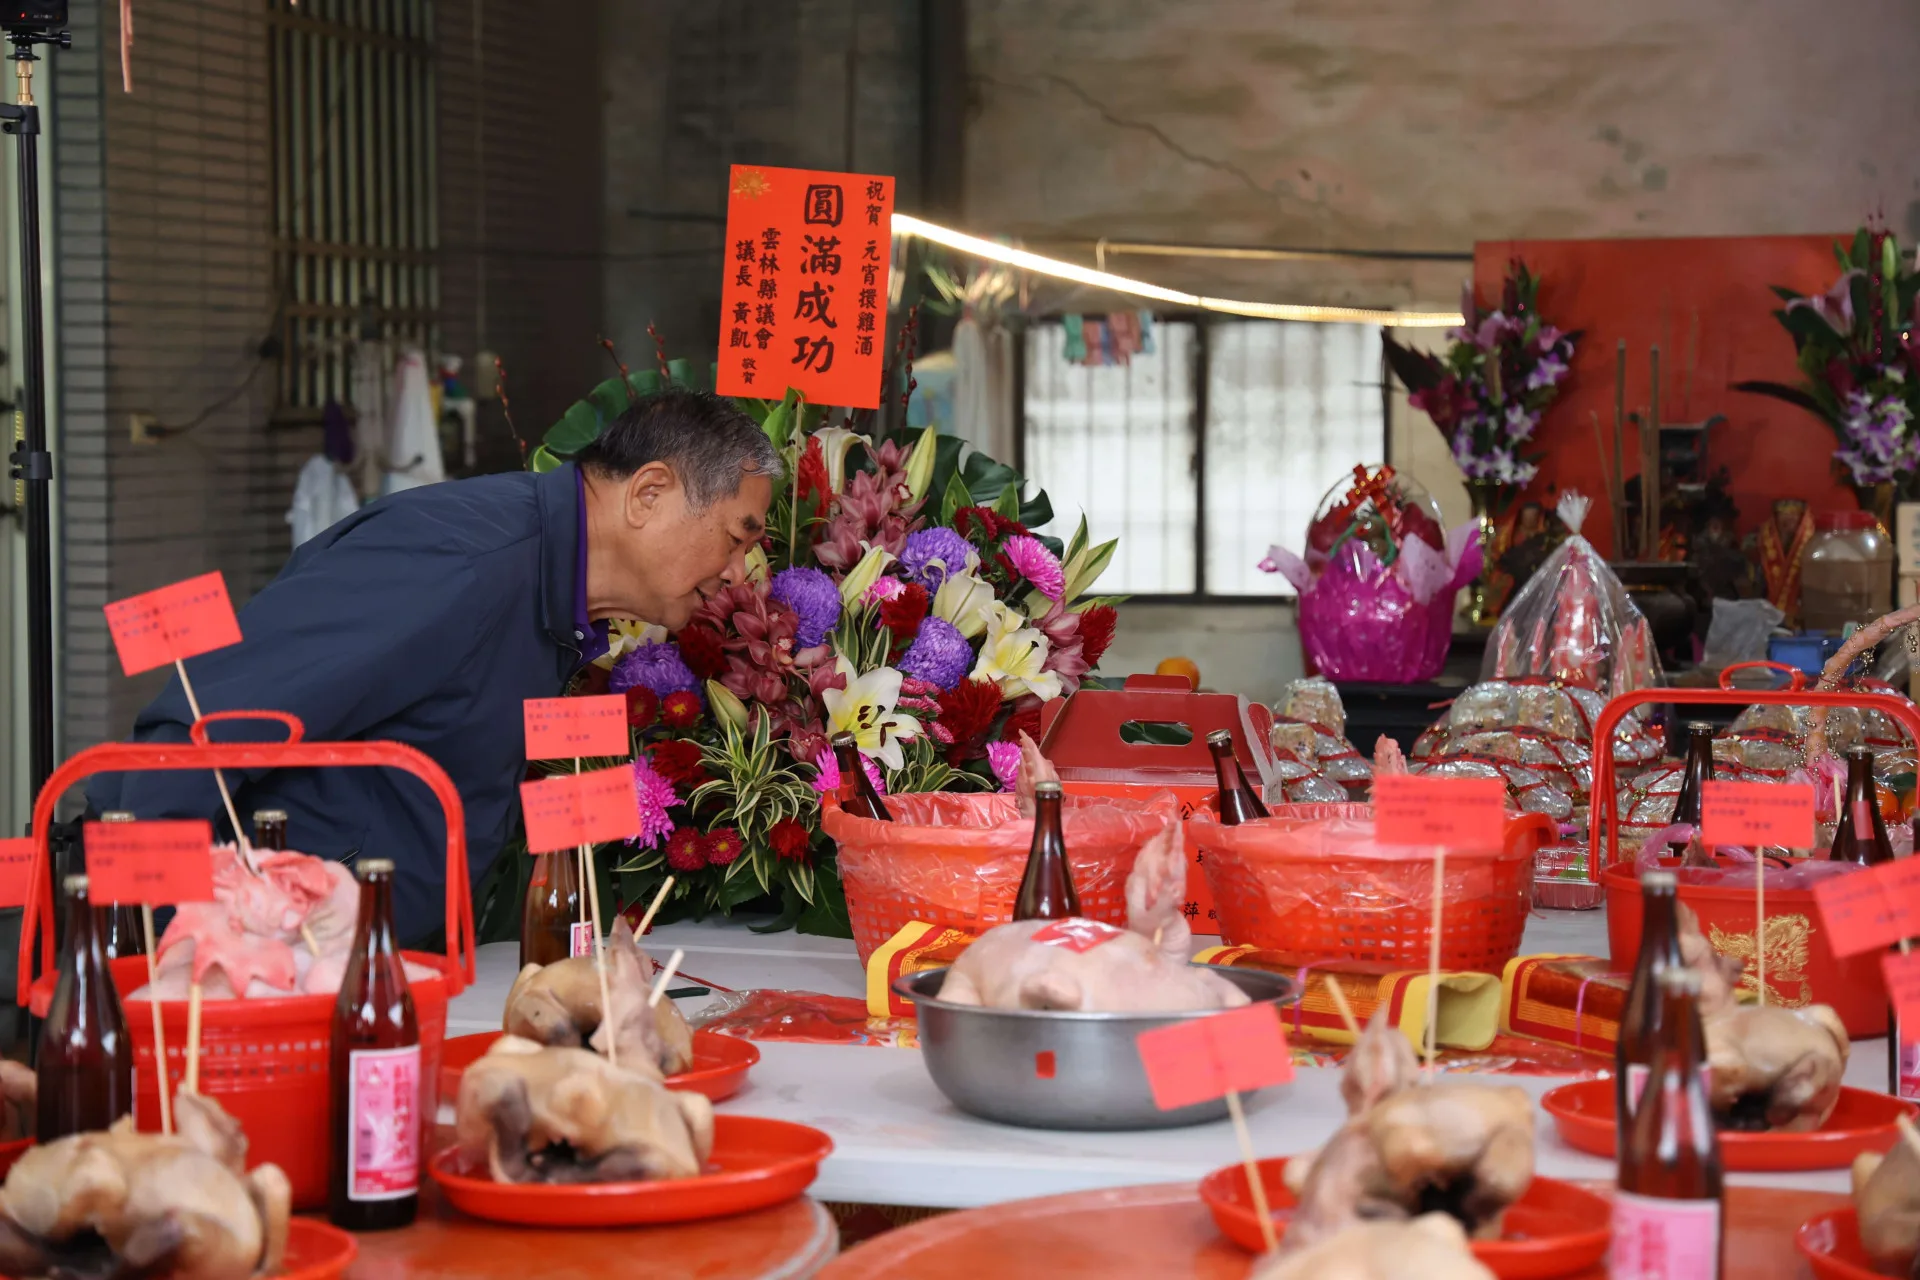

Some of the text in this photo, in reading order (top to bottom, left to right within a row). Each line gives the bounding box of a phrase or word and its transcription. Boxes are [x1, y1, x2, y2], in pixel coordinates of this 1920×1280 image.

[866, 180, 885, 226] 祝賀
[736, 240, 756, 287] 議長
[791, 184, 844, 374] 圓滿成功
[754, 227, 781, 350] 雲林縣議會
[729, 301, 752, 349] 黃凱
